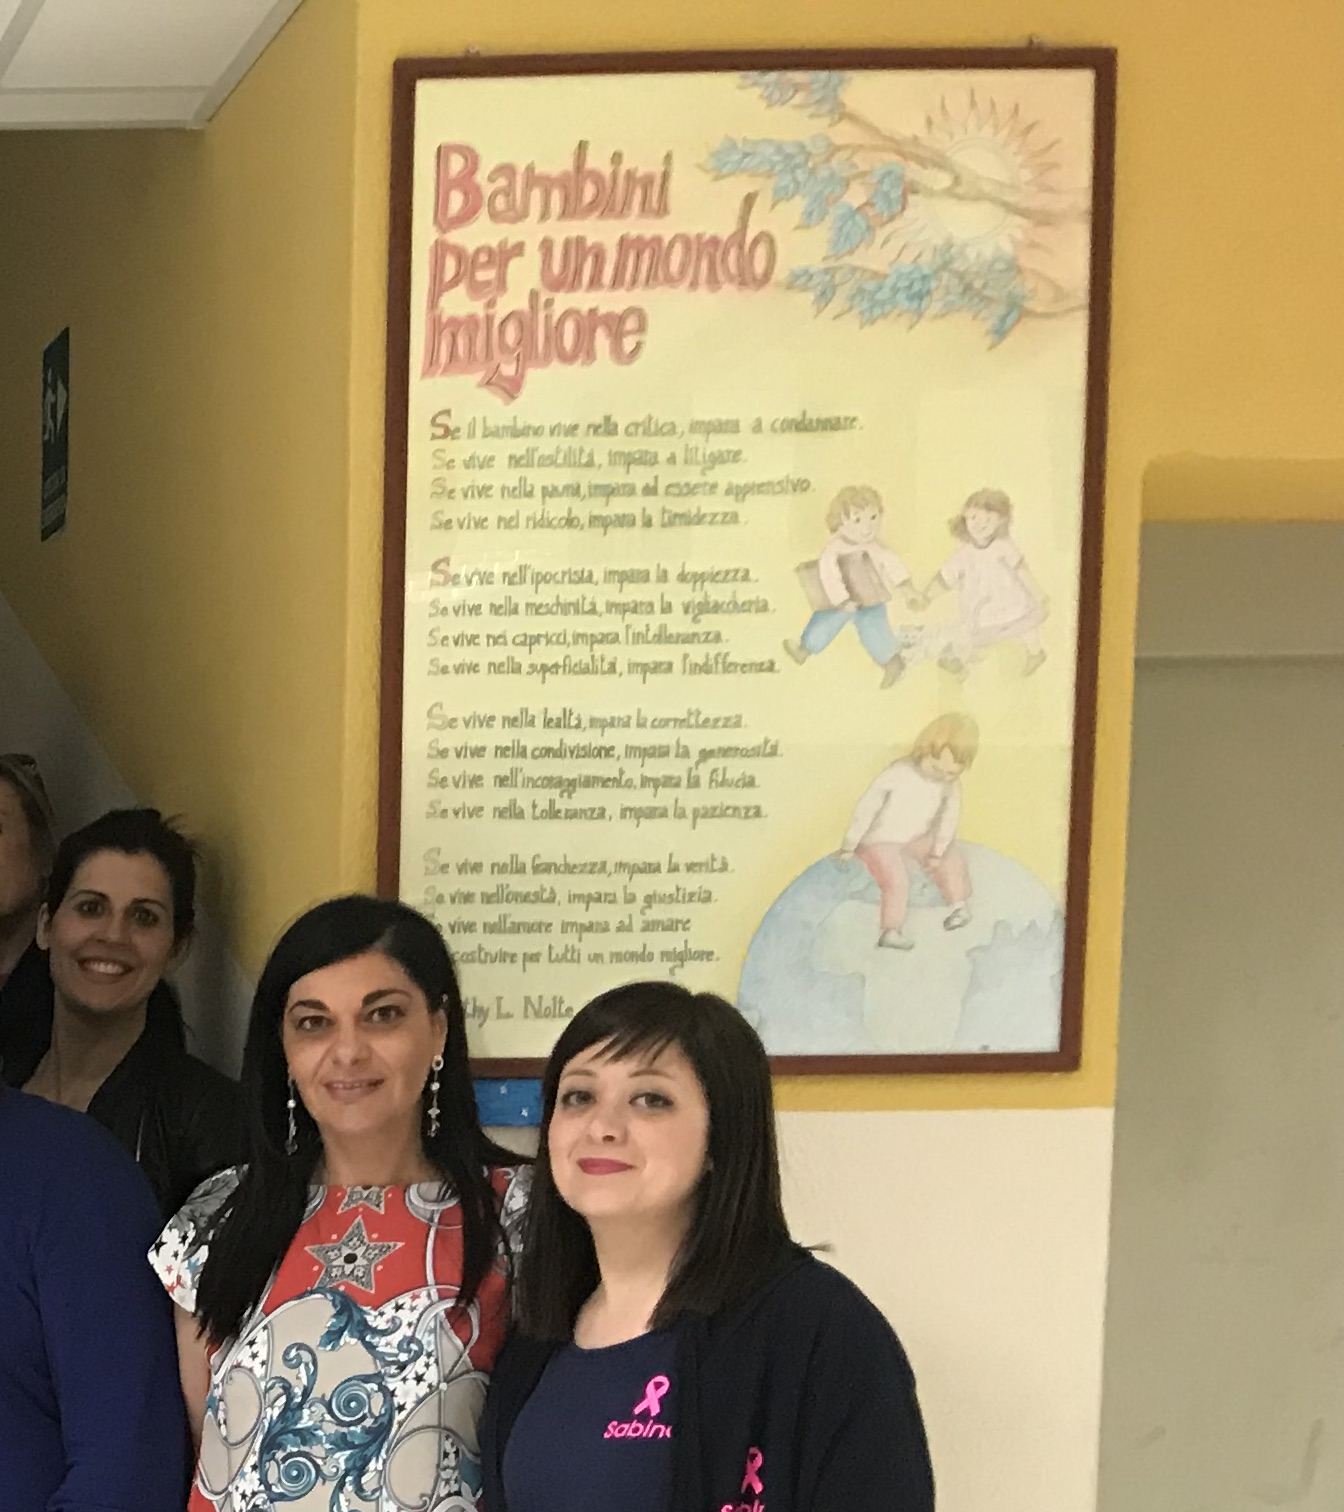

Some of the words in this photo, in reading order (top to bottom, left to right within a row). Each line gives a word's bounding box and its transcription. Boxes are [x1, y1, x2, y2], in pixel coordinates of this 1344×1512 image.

[432, 140, 674, 234] Bambini
[425, 236, 524, 308] per
[610, 191, 777, 292] mondo
[421, 287, 648, 403] migliore
[430, 408, 461, 441] Se
[482, 415, 544, 439] bambino
[549, 417, 579, 438] vive
[586, 414, 618, 437] nella
[689, 417, 741, 442] impara
[751, 417, 762, 434] a
[431, 448, 456, 470] Se
[462, 452, 495, 469] vive
[608, 448, 659, 474] impara
[666, 451, 676, 466] a
[429, 477, 455, 500] Se
[461, 479, 493, 498] vive
[500, 475, 534, 499] nella
[642, 475, 658, 497] ad
[429, 509, 453, 531] Se
[457, 511, 489, 530] vive
[497, 510, 520, 530] nel
[588, 510, 636, 536] impara
[641, 507, 653, 529] la
[429, 555, 461, 588] Se
[464, 567, 495, 586] vive
[603, 567, 650, 593] impara
[656, 561, 669, 583] la
[428, 597, 449, 618] Se
[453, 599, 483, 616] vive
[489, 595, 520, 617] nella
[605, 598, 654, 623] impara
[660, 592, 672, 614] la
[427, 626, 449, 648] Se
[452, 630, 480, 647] vive
[572, 629, 621, 652] impara
[427, 656, 450, 677] Se
[453, 658, 480, 675] vive
[487, 655, 522, 676] nella
[627, 657, 673, 684] impara
[426, 701, 458, 732] Se
[462, 711, 496, 729] vive
[502, 707, 536, 729] nella
[636, 707, 648, 729] la
[427, 738, 449, 760] Se
[454, 741, 487, 760] vive
[494, 738, 528, 760] nella
[531, 738, 621, 762] condivisione,
[624, 743, 670, 769] impara
[674, 737, 690, 760] la
[426, 767, 449, 789] Se
[451, 770, 485, 789] vive
[640, 772, 682, 798] impara
[686, 767, 701, 789] la
[425, 798, 448, 820] Se
[452, 802, 484, 820] vive
[492, 798, 525, 820] nella
[620, 803, 668, 828] impara
[673, 797, 688, 819] la
[422, 847, 450, 876] Se
[455, 858, 484, 876] vive
[490, 853, 527, 875] nella
[614, 860, 662, 882] impara
[667, 852, 680, 874] la
[449, 888, 476, 905] vive
[568, 889, 618, 912] impara
[623, 884, 637, 905] la
[448, 916, 478, 935] vive
[561, 918, 611, 943] impara
[615, 913, 634, 933] ad
[640, 916, 691, 933] amare
[522, 950, 543, 973] per
[547, 943, 582, 965] tutti
[587, 952, 605, 965] un
[609, 942, 655, 965] mondo
